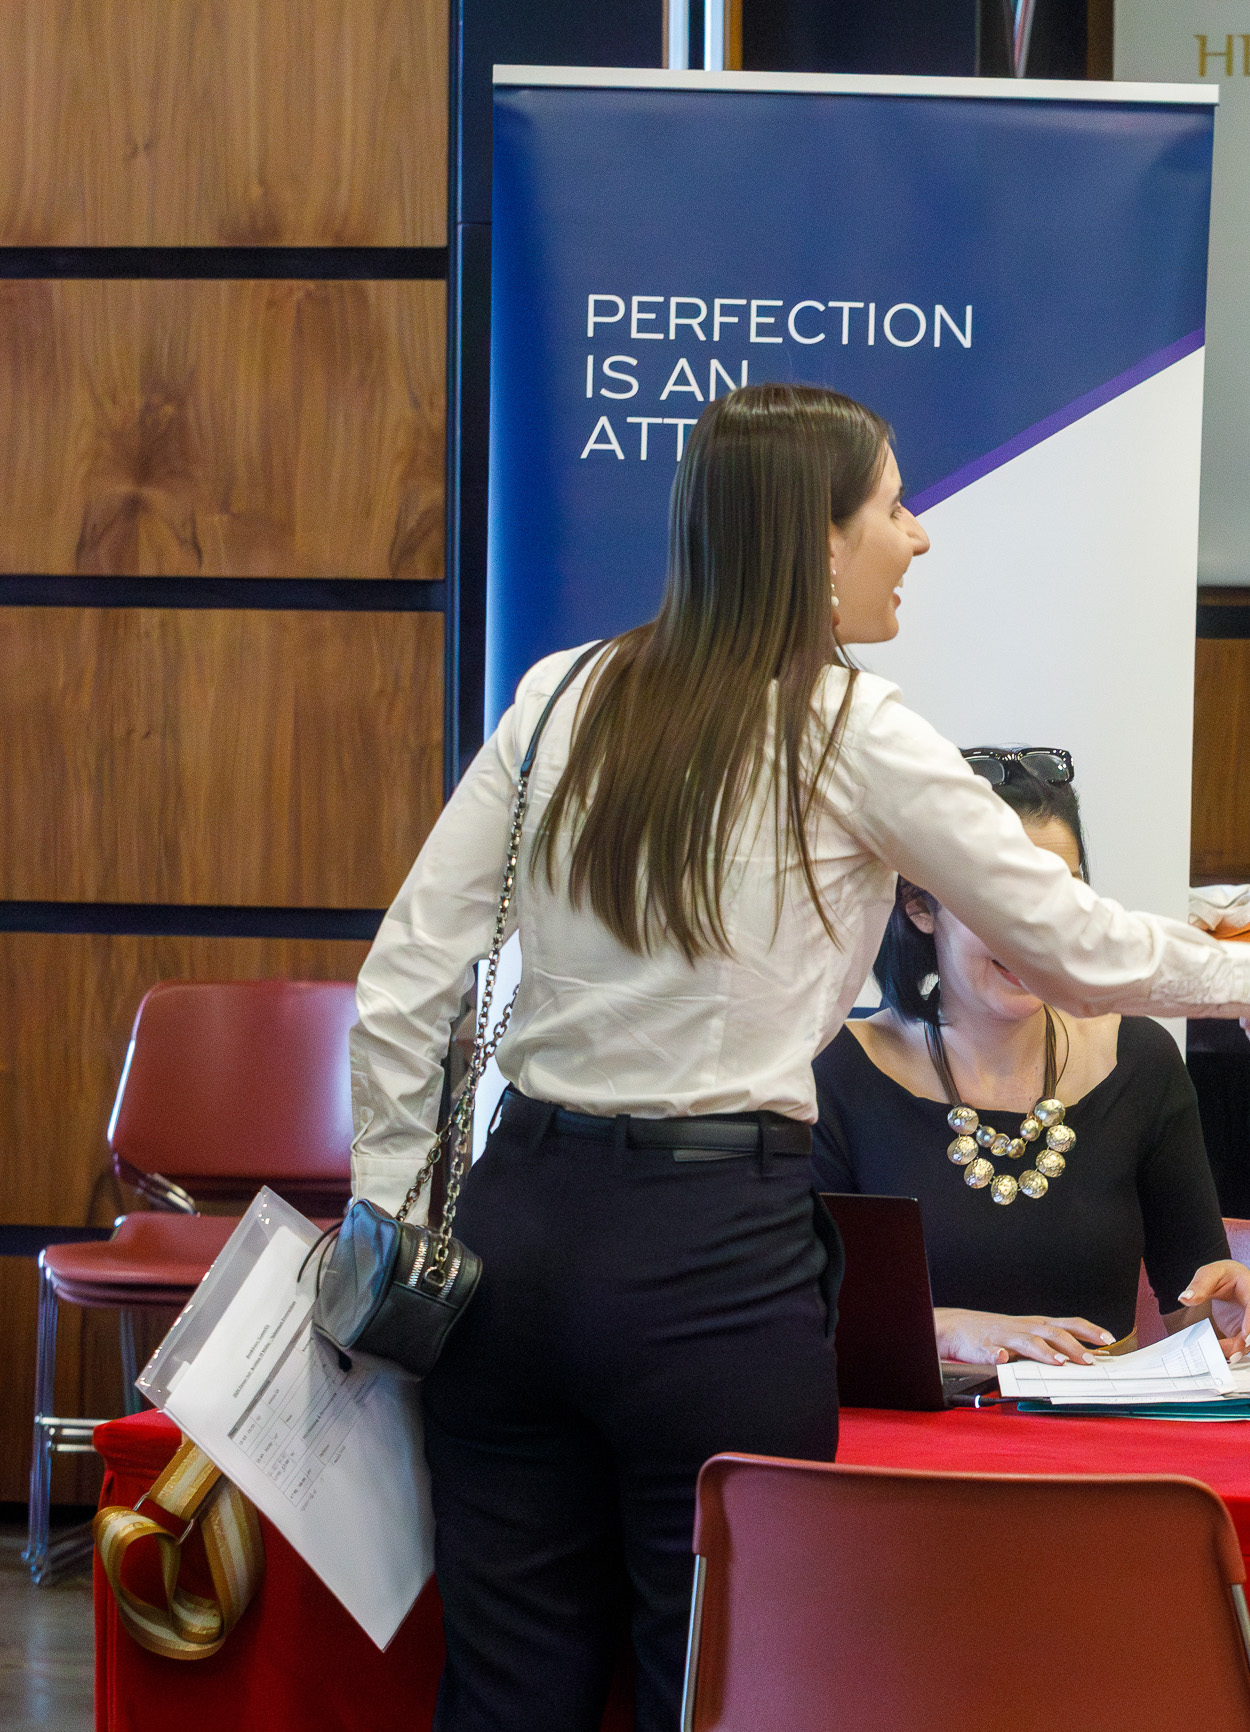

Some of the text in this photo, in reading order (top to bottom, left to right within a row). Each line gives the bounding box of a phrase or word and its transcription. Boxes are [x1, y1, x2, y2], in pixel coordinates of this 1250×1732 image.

[586, 294, 974, 349] PERFECTION
[586, 354, 749, 402] IS AN
[580, 415, 699, 462] ATT
